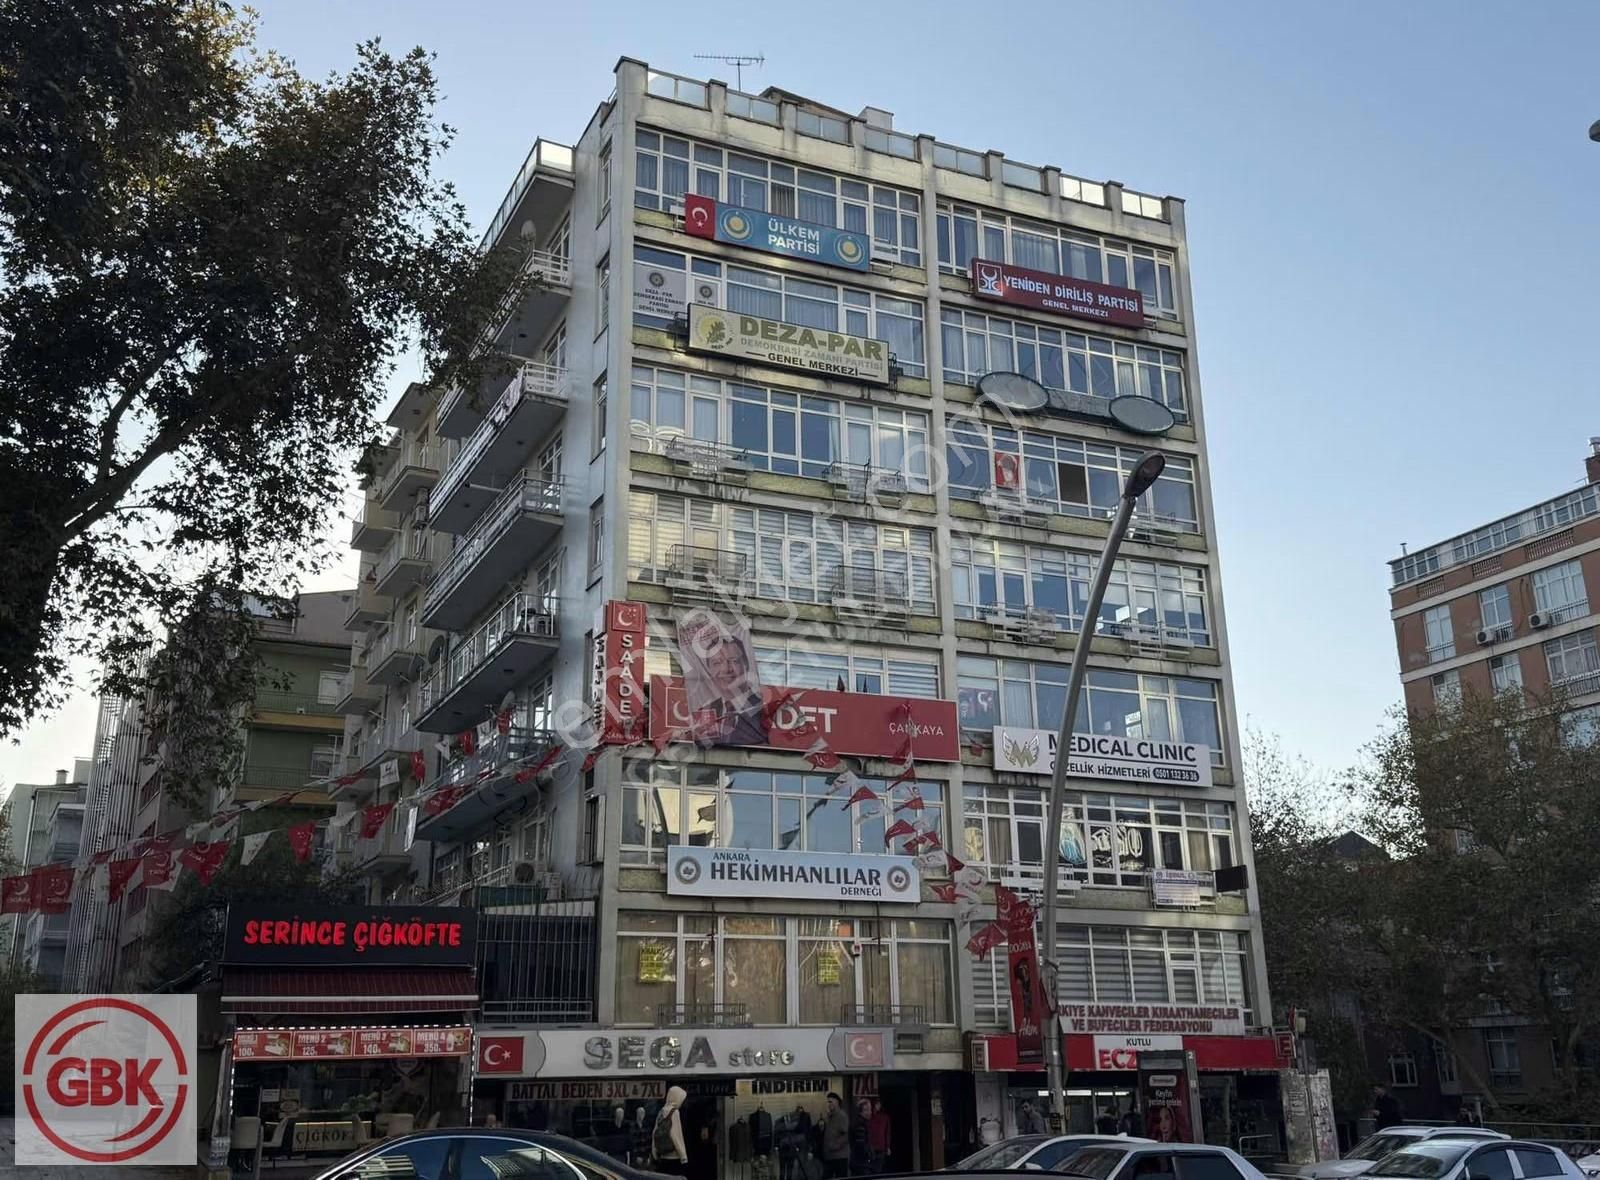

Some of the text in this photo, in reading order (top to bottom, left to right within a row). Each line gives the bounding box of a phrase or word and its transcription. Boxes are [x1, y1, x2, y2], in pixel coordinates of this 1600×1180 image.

[768, 216, 820, 241] ÜLKEM
[768, 234, 820, 256] PARTİSİ
[1003, 275, 1138, 313] YENİDEN DİRİLİŞ PARTİSİ
[1042, 299, 1070, 311] GENEL
[739, 316, 883, 361] DEZA-PAR
[768, 352, 859, 377] GENEL MERKEZİ
[1048, 734, 1196, 763] MEDICAL CLINIC
[1098, 763, 1150, 779] HİZMETLERİ
[712, 852, 751, 862] ANKARA
[710, 859, 881, 887] HEKİMHANLILAR
[243, 915, 462, 952] SERİNCE ÇİĞKÖFTE
[1071, 1018, 1085, 1031] VE
[583, 1036, 795, 1070] SEGA store
[1126, 1037, 1151, 1047] KUTLU
[1098, 1049, 1137, 1070] ECZ
[511, 1082, 557, 1100] BATTAL
[561, 1081, 603, 1098] BEDEN
[606, 1081, 630, 1098] 3XL
[640, 1081, 663, 1098] 7XL
[853, 1074, 879, 1096] 7XL
